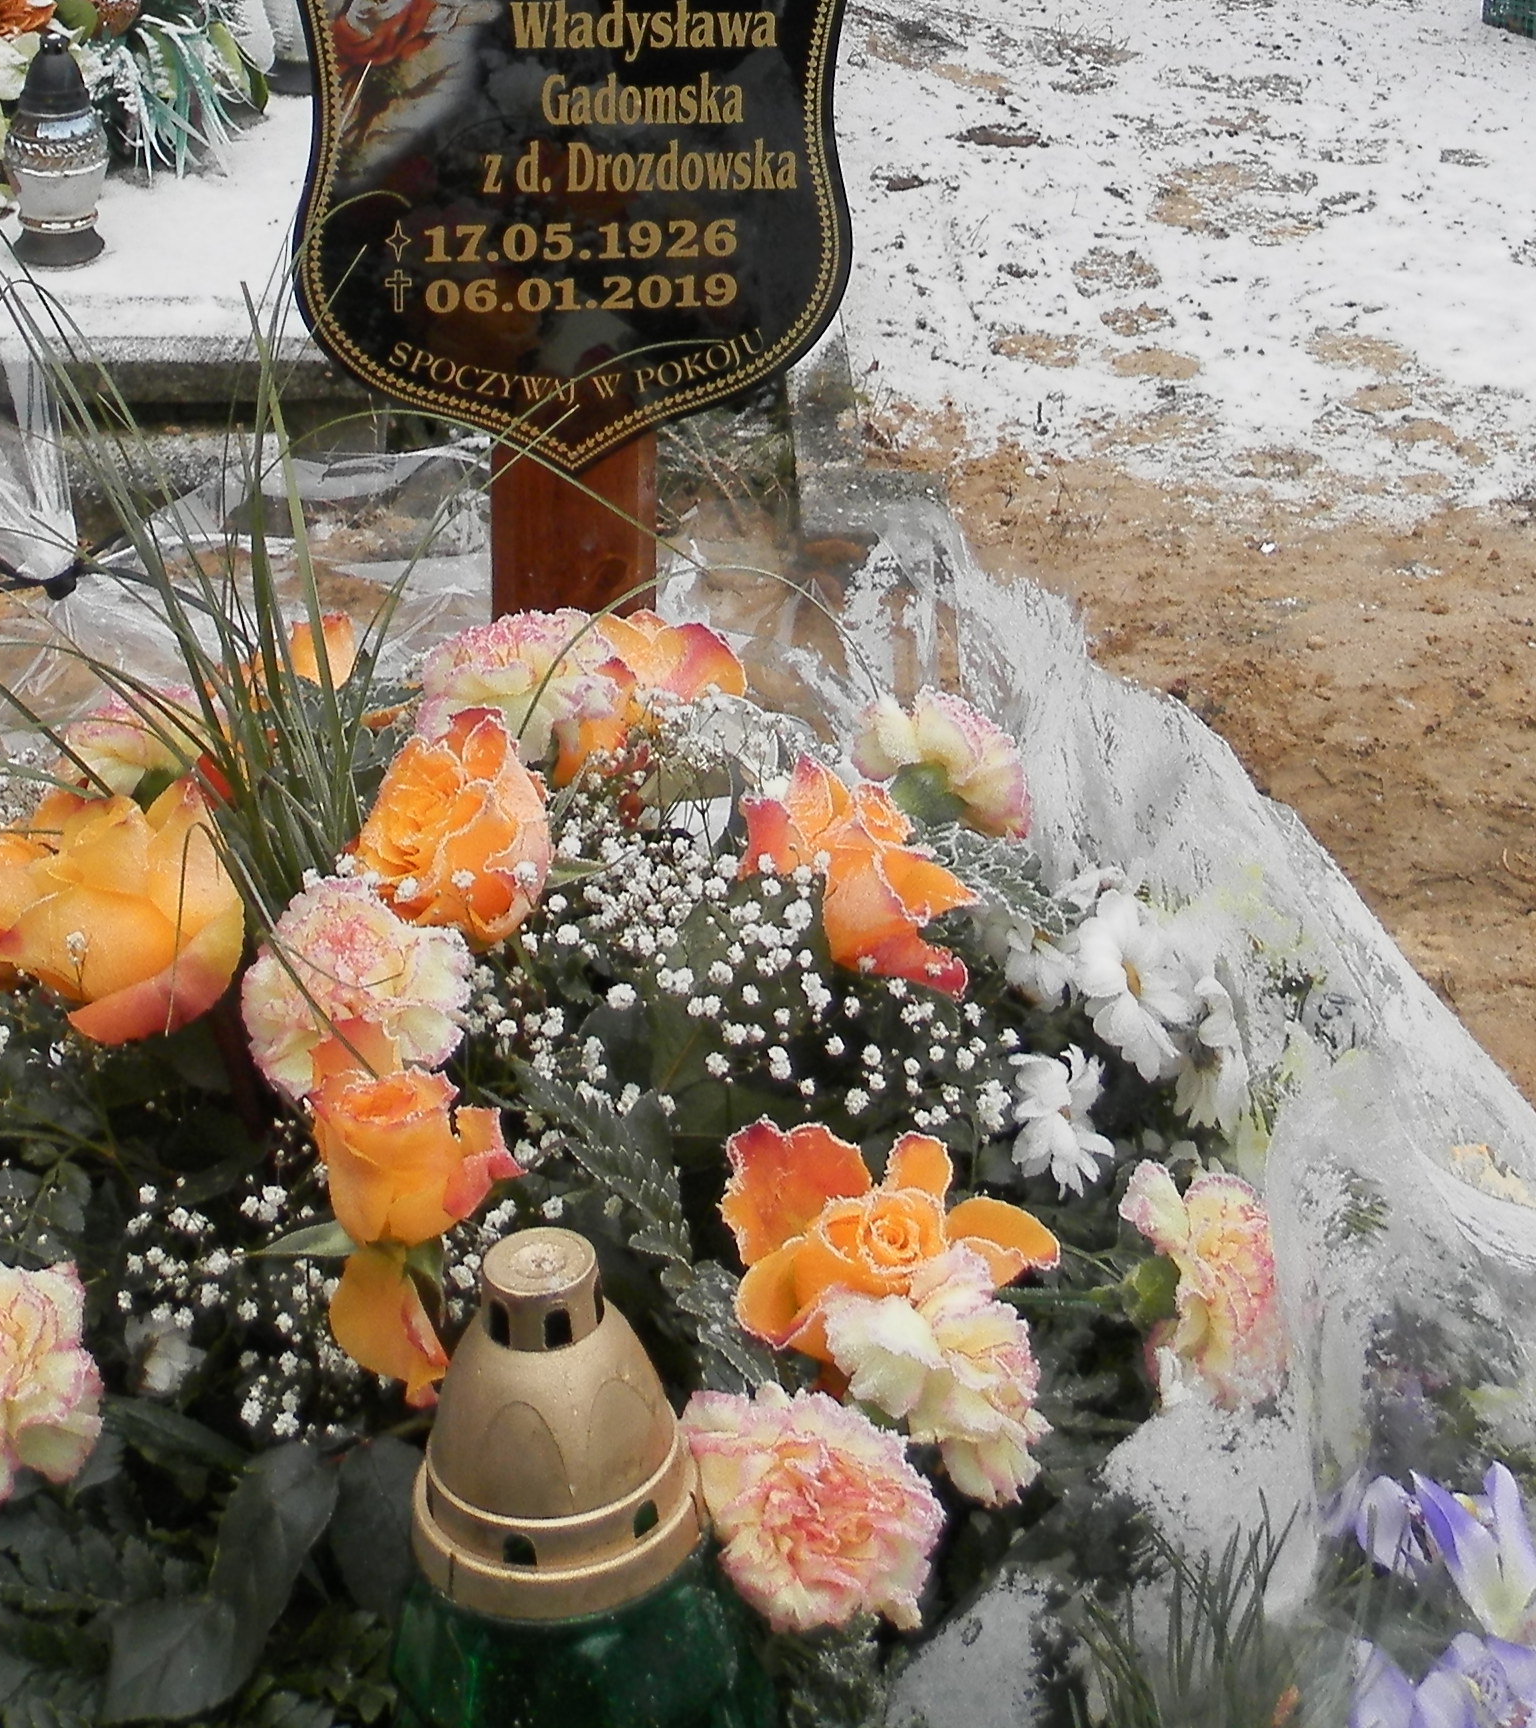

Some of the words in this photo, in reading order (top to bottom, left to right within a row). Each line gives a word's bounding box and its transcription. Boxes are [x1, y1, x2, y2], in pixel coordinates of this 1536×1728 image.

[510, 0, 777, 62] Władysława
[541, 74, 744, 125] Gadomska
[482, 153, 502, 193] z
[516, 141, 552, 193] d.
[568, 139, 798, 192] Drozdowska
[424, 219, 739, 263] 17.05.1926
[424, 273, 739, 315] 06.01.2019
[388, 340, 576, 405] SPOCZYWAJ
[591, 373, 622, 400] W
[635, 326, 765, 393] POKOJU
